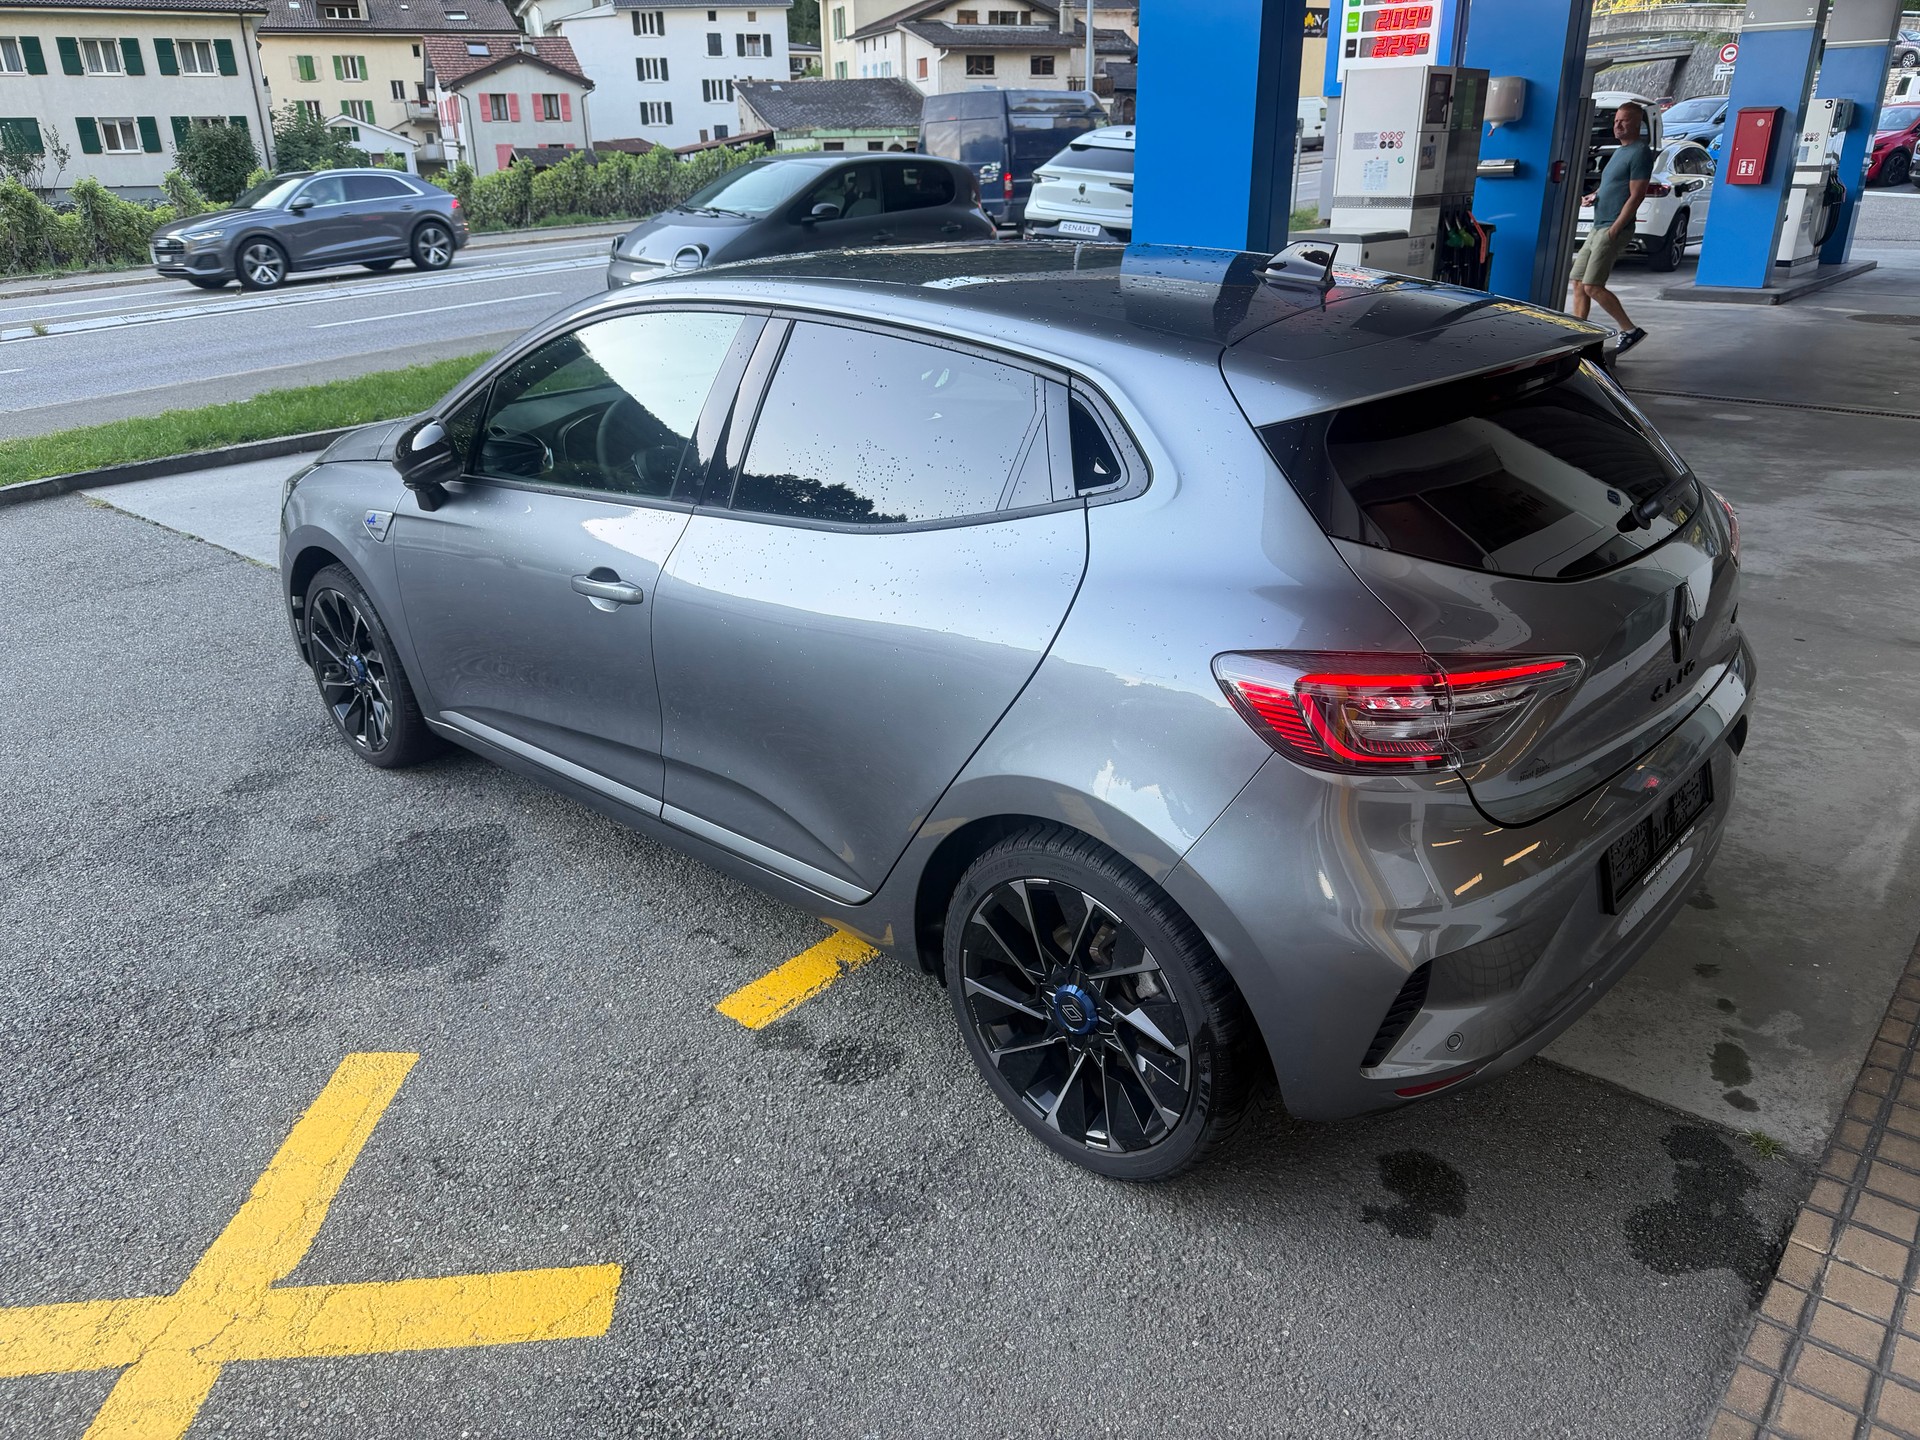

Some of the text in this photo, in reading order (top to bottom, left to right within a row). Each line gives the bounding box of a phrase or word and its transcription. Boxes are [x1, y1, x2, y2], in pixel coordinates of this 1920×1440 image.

[1748, 11, 1756, 20] 4
[1806, 7, 1814, 16] 3
[1824, 99, 1834, 109] 3
[1062, 223, 1096, 233] RENAULT
[1651, 658, 1696, 703] CLIO
